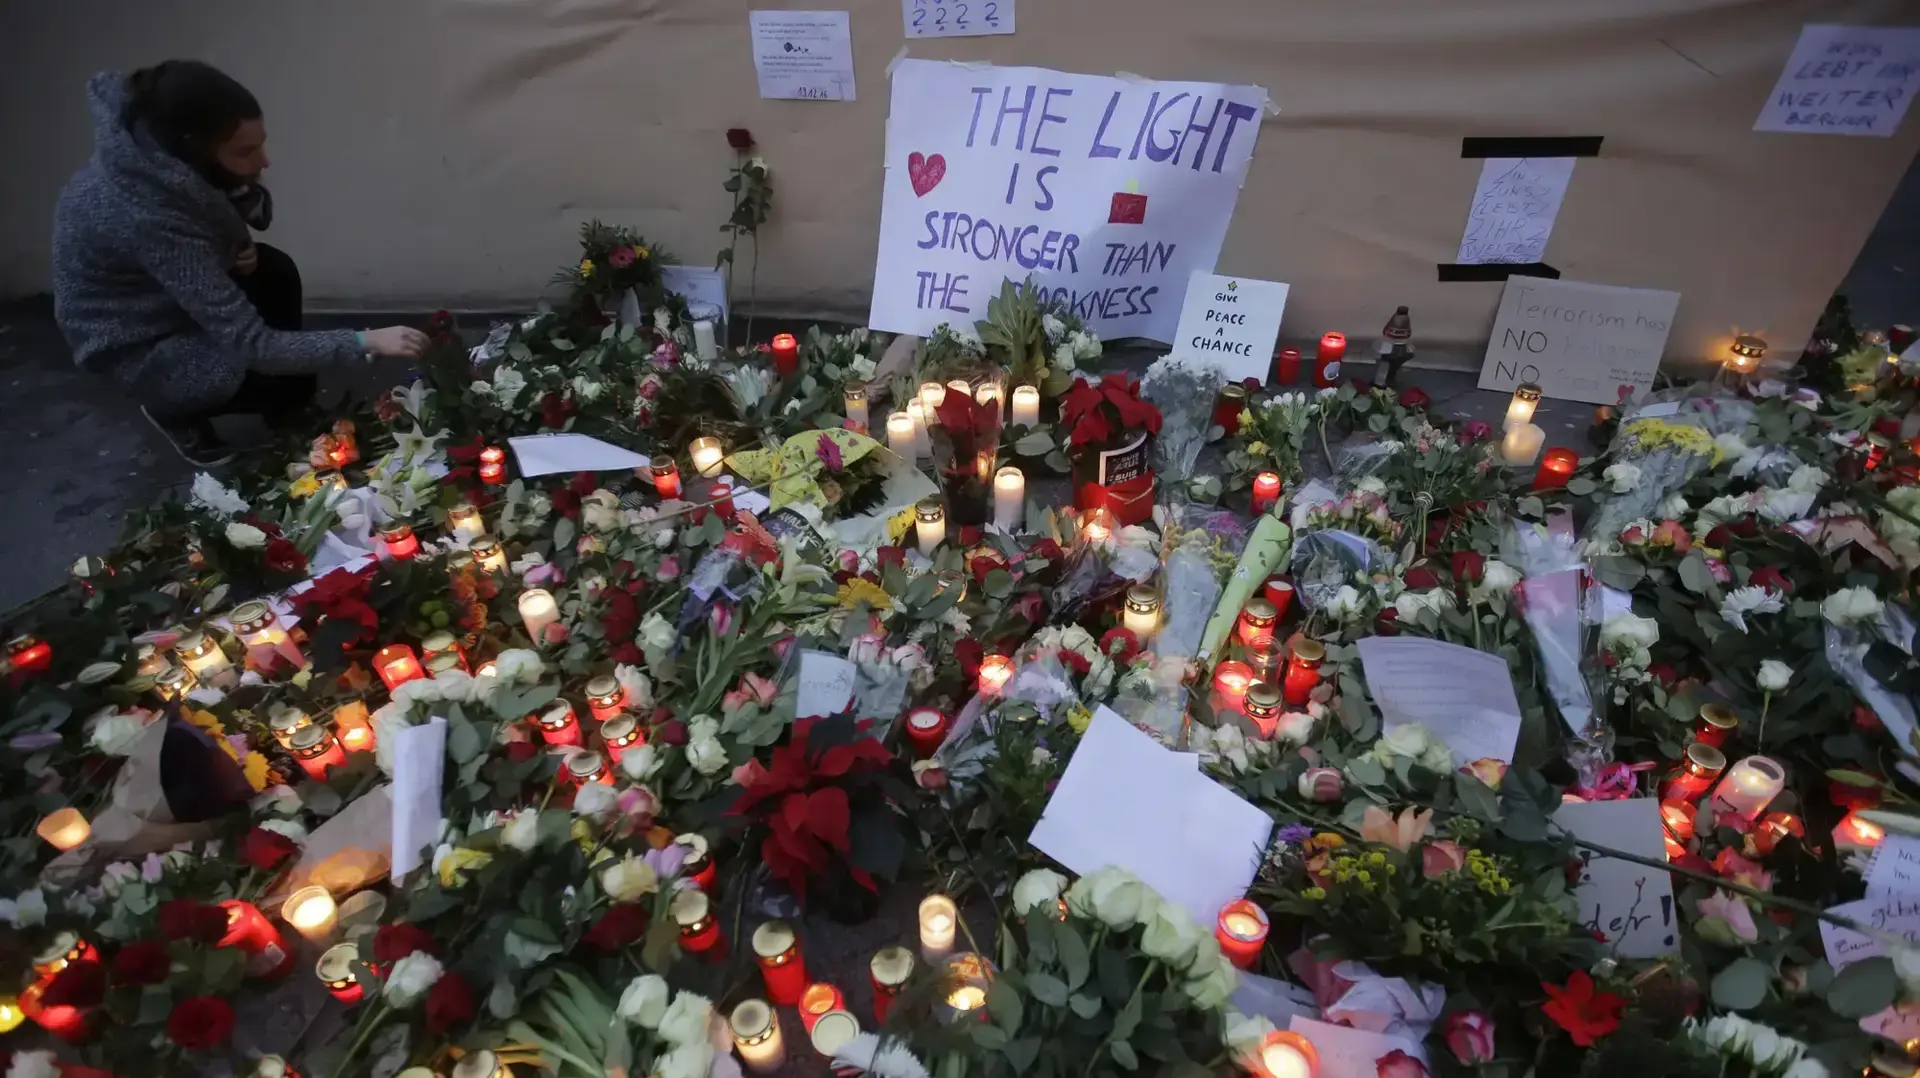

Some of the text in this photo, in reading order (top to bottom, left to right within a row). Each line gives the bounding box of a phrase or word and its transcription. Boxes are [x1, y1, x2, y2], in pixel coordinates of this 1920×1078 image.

[1793, 60, 1874, 80] LEBT
[1778, 86, 1904, 112] WEITER
[965, 85, 1257, 174] THE LIGHT
[1006, 163, 1059, 211] IS
[917, 211, 1176, 276] STRONGER THAN
[917, 271, 1159, 320] THE ARKNESS
[1215, 292, 1238, 303] GIVE
[1205, 309, 1246, 325] PEACE
[1516, 286, 1668, 332] Terrorism has
[1215, 327, 1224, 337] A
[1503, 328, 1548, 353] NO
[1192, 336, 1253, 357] CHANCE
[1495, 361, 1540, 384] NO
